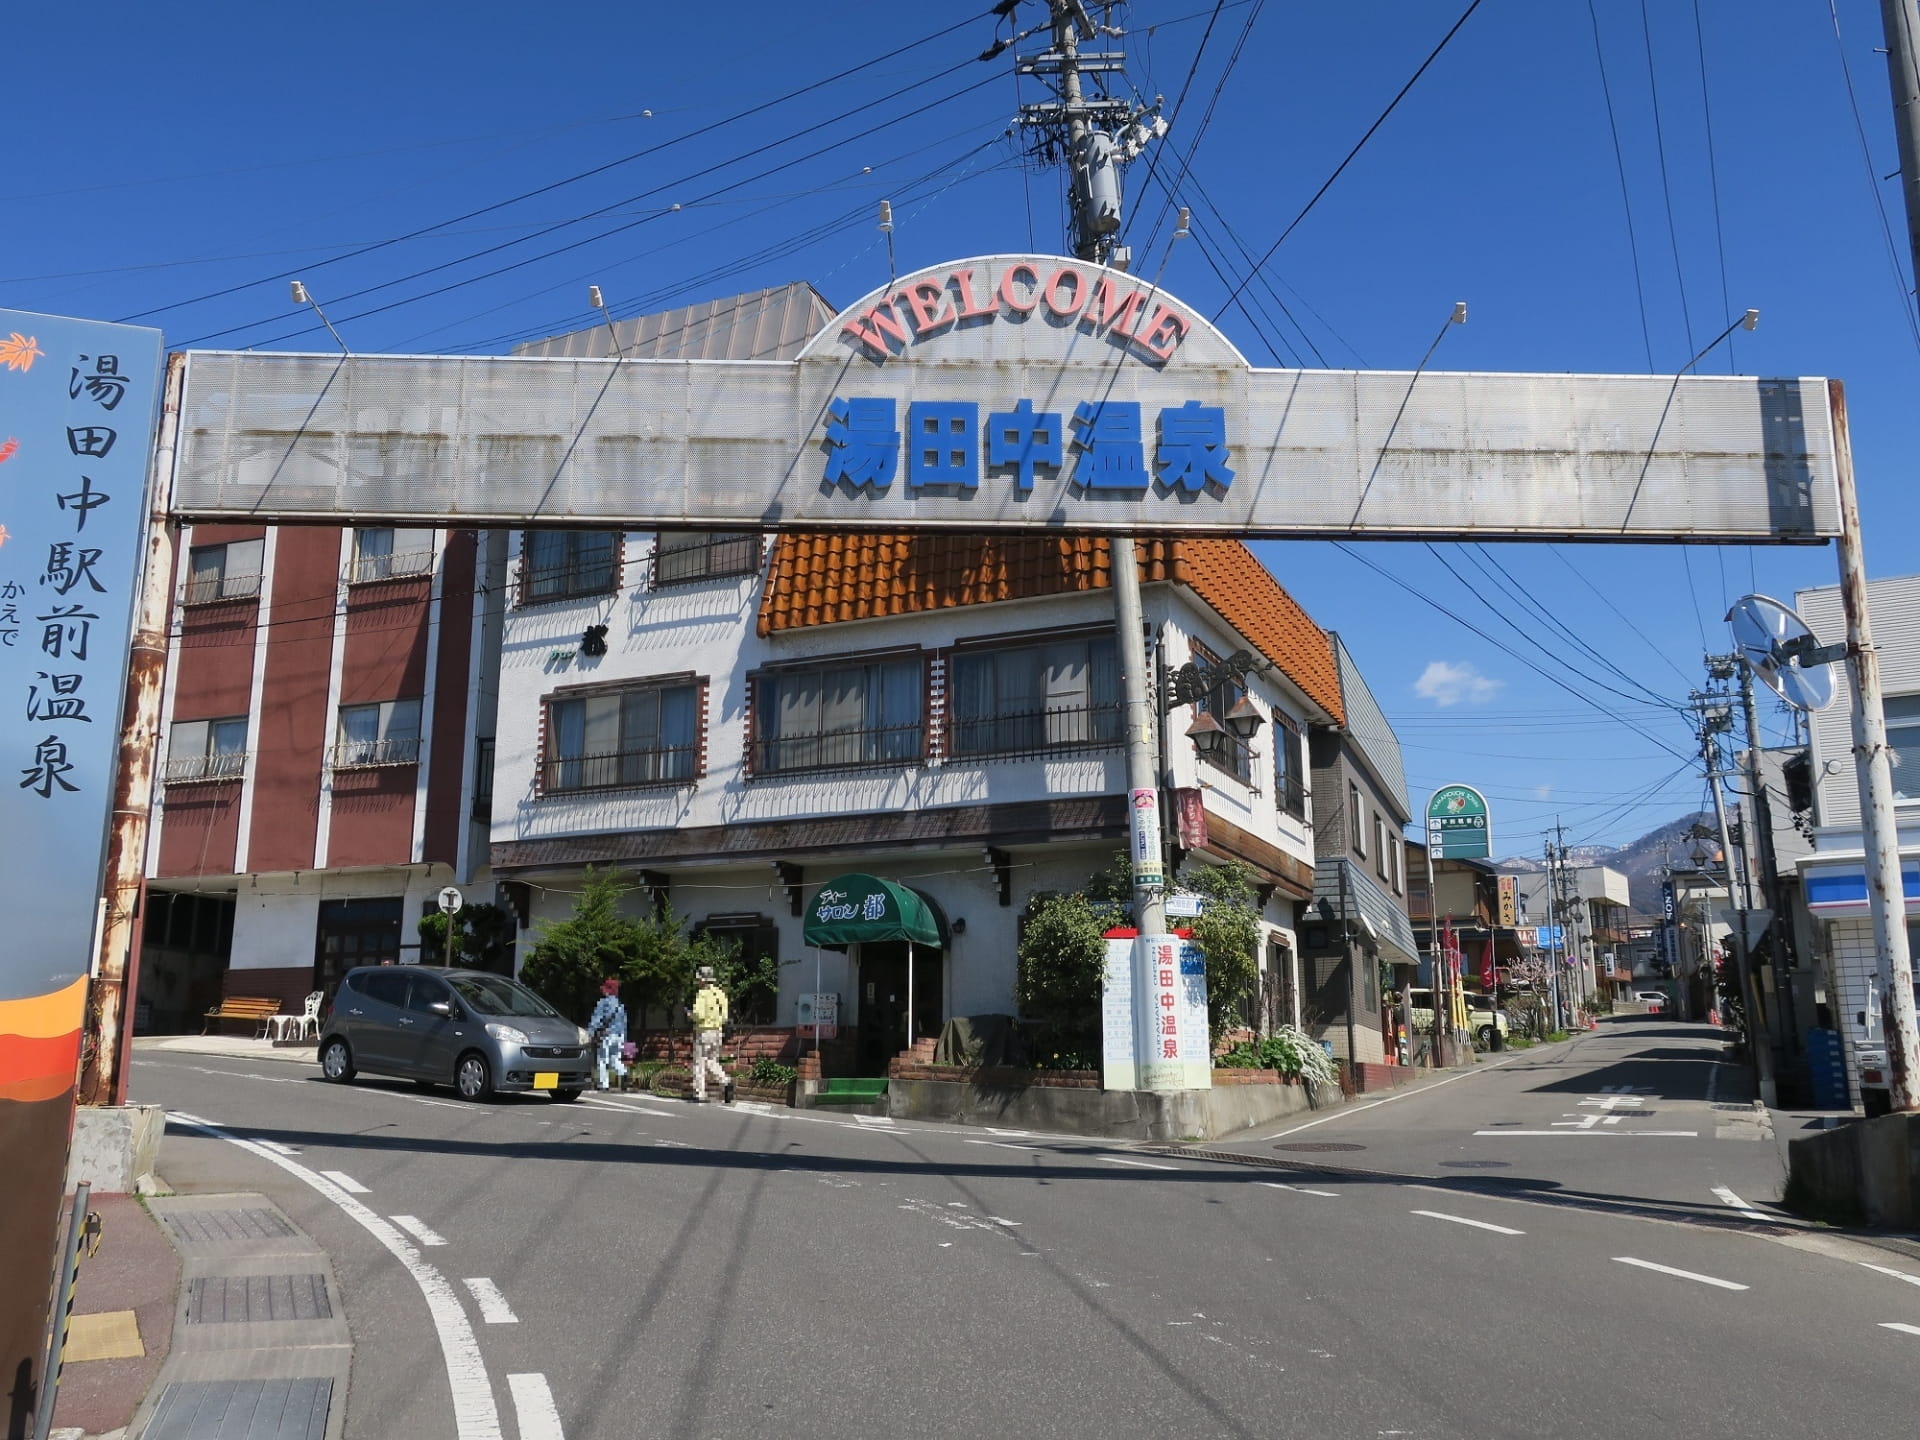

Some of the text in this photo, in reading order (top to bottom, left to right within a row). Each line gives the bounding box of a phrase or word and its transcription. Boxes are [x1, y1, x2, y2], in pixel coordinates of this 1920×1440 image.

[843, 263, 1191, 360] WELCOME
[823, 397, 1236, 492] 湯田中温泉
[20, 353, 130, 799] 湯田中駅前温泉
[0, 580, 25, 646] かえで
[816, 892, 885, 923] サロン 都
[819, 889, 847, 905] ディー
[1503, 891, 1512, 922] みかさ
[1664, 888, 1673, 920] SONY
[1154, 992, 1162, 1058] YUDANAKA
[1157, 945, 1178, 1059] 湯田中温泉
